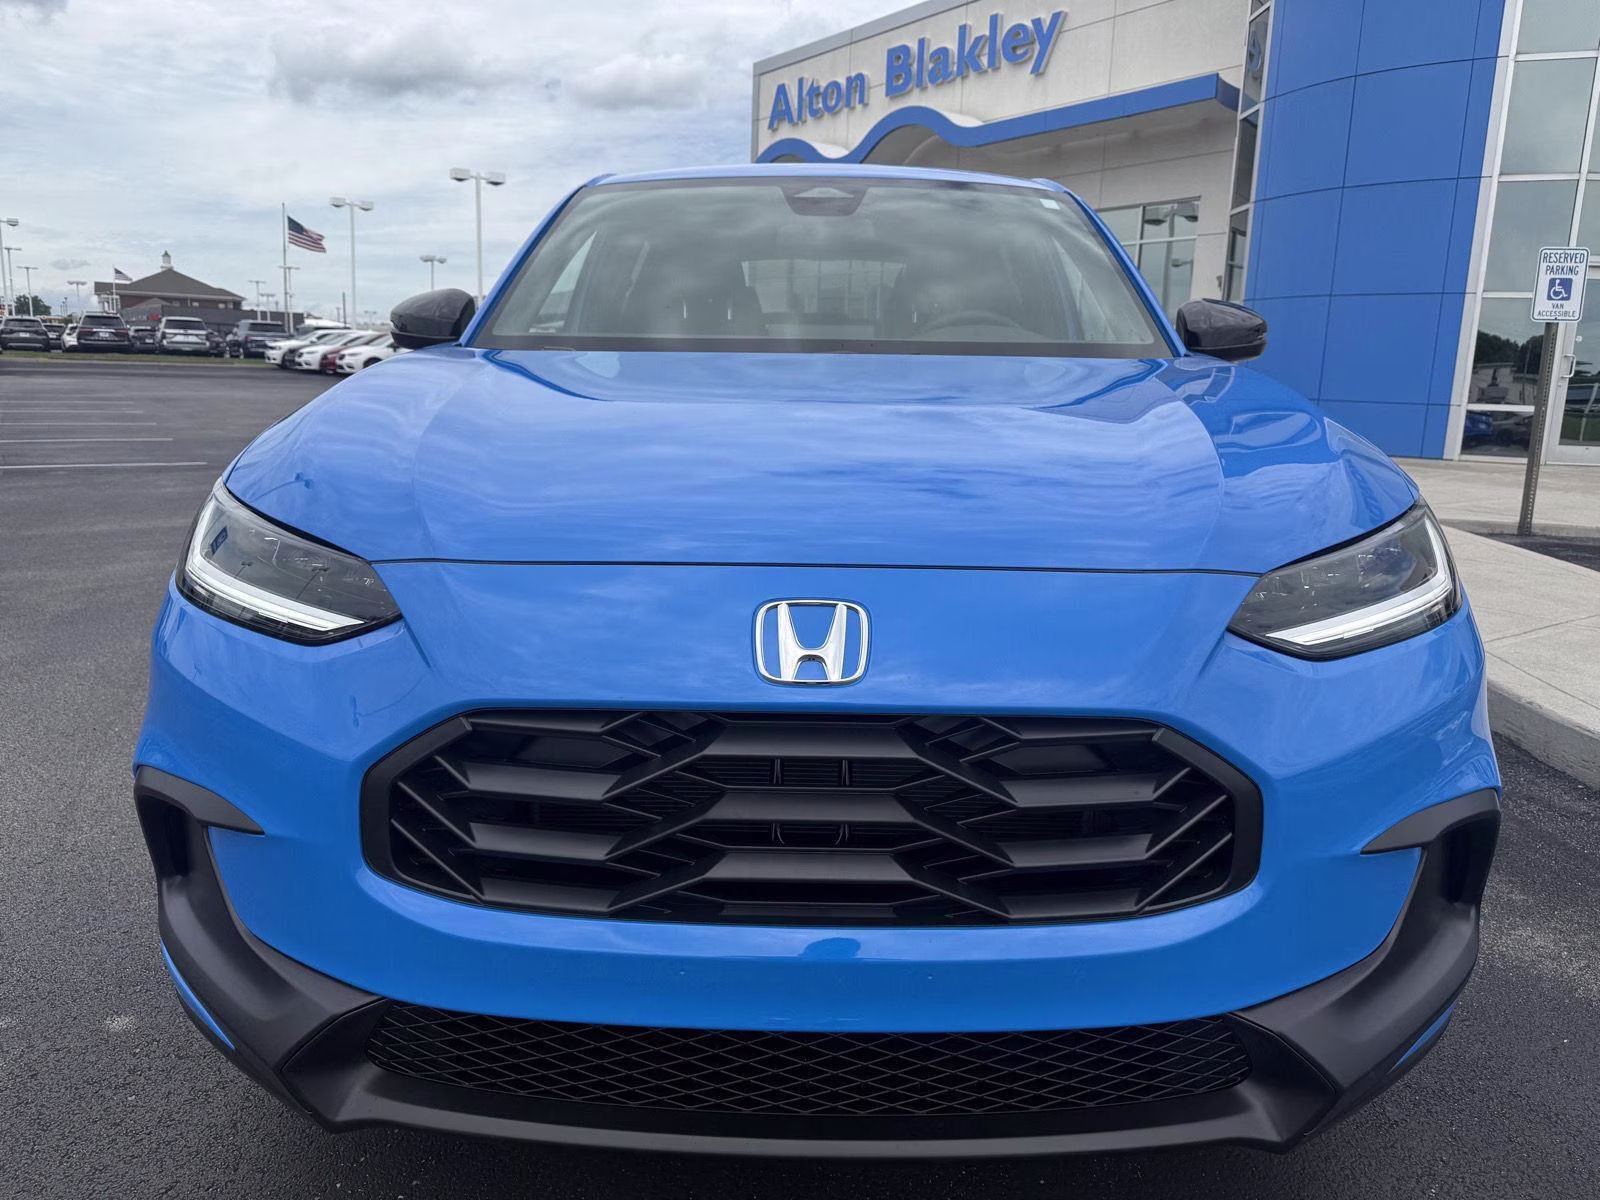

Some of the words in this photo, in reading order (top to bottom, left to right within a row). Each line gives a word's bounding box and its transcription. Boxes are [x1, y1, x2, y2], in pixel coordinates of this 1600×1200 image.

[768, 72, 869, 130] Alton
[885, 10, 1067, 98] Blakley
[1542, 252, 1585, 264] RESERVED
[1545, 265, 1579, 276] PARKING
[1537, 310, 1576, 318] ACCESSIBLE
